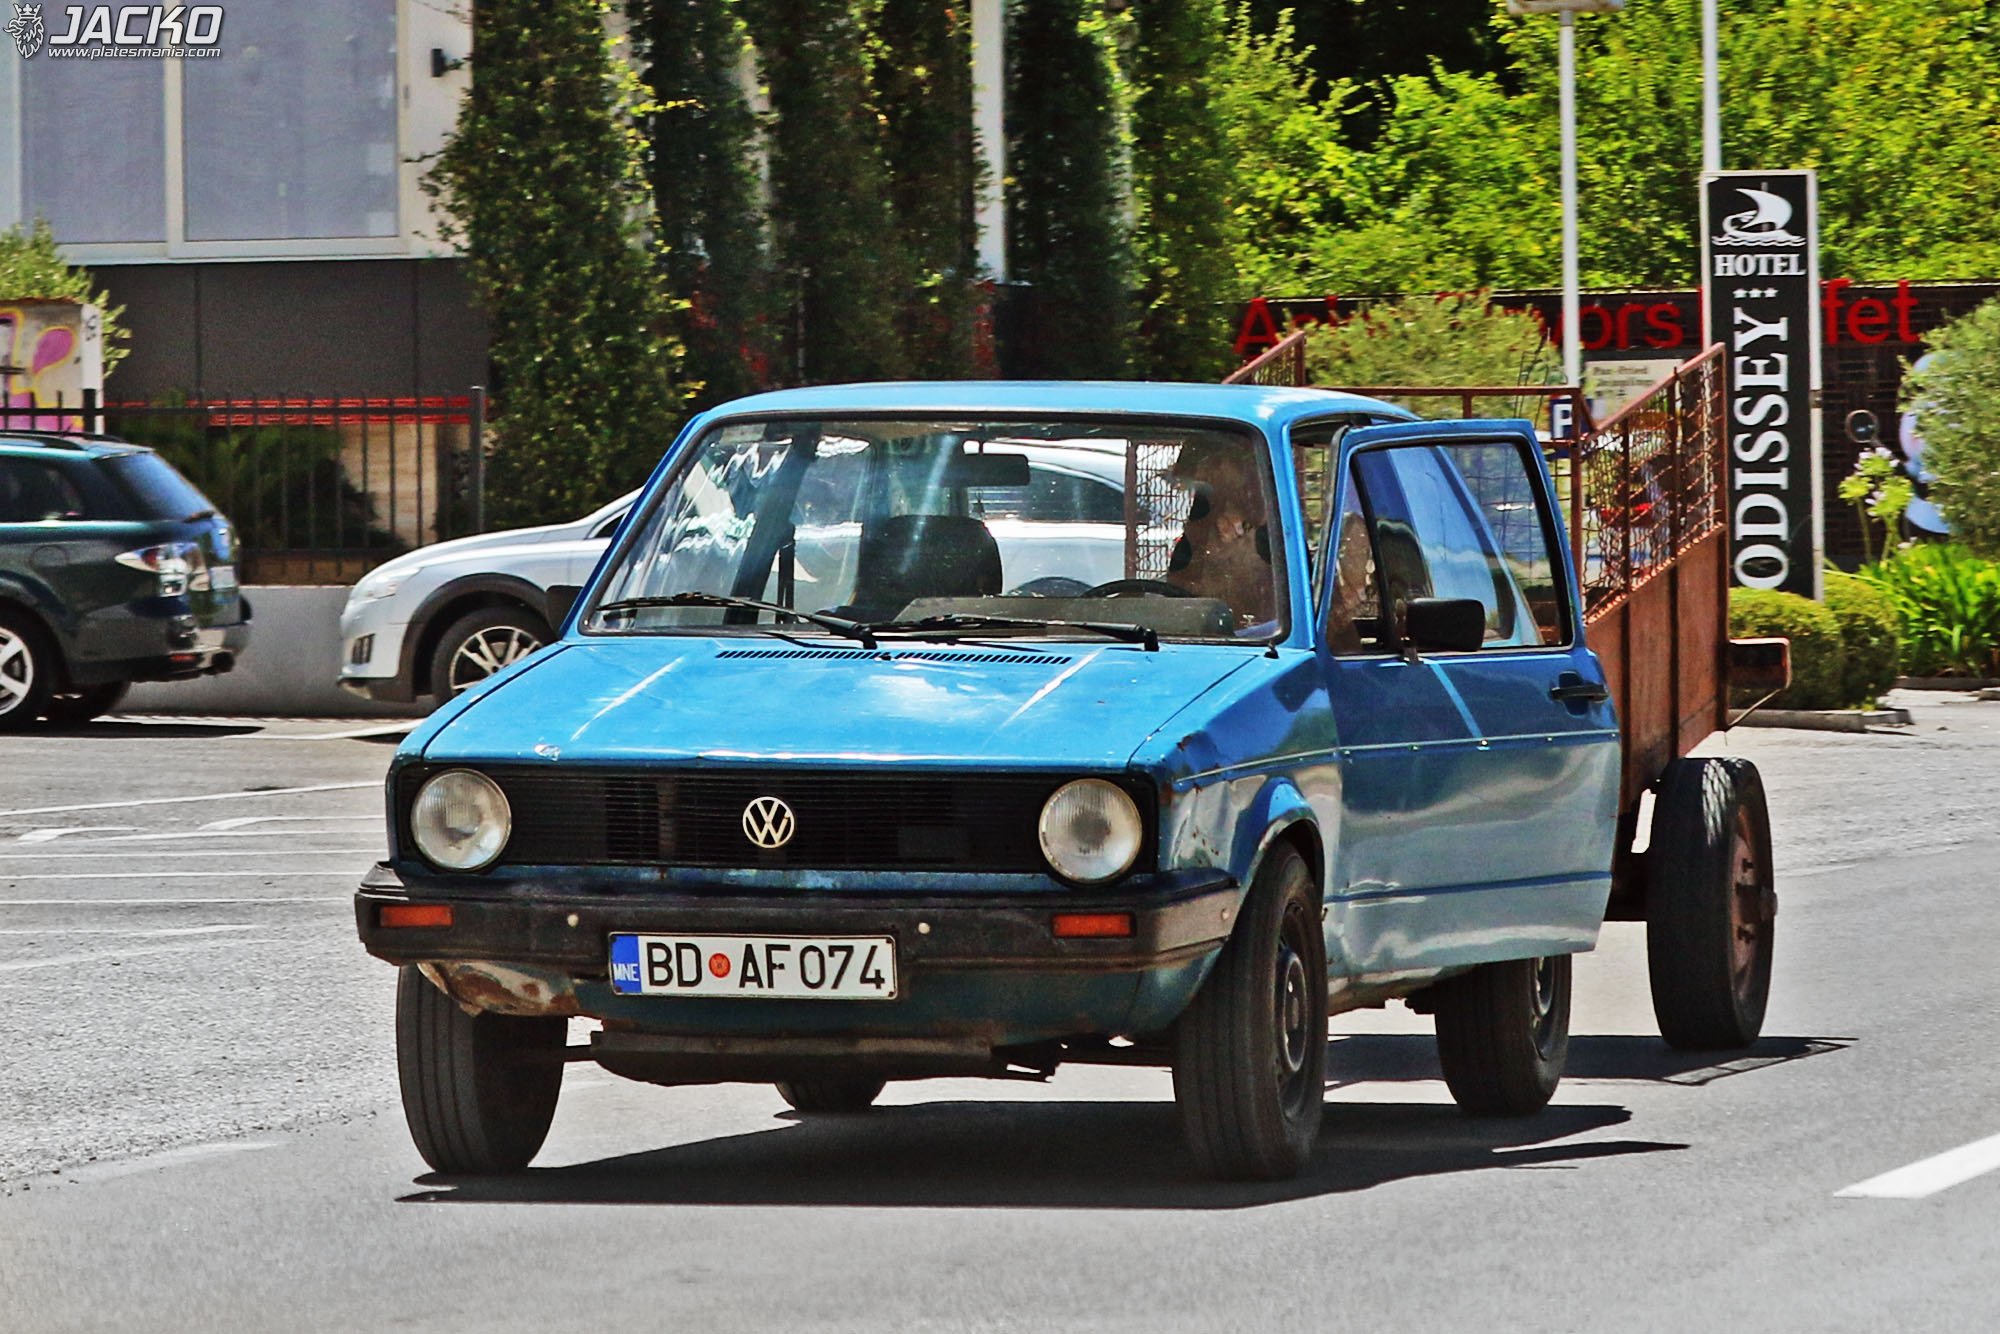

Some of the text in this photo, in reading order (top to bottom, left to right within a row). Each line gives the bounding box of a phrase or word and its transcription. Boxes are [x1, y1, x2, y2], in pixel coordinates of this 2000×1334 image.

[1714, 253, 1806, 277] HOTEL
[1733, 306, 1790, 591] ODISSEY
[612, 962, 640, 982] MNE
[646, 942, 703, 988] BD
